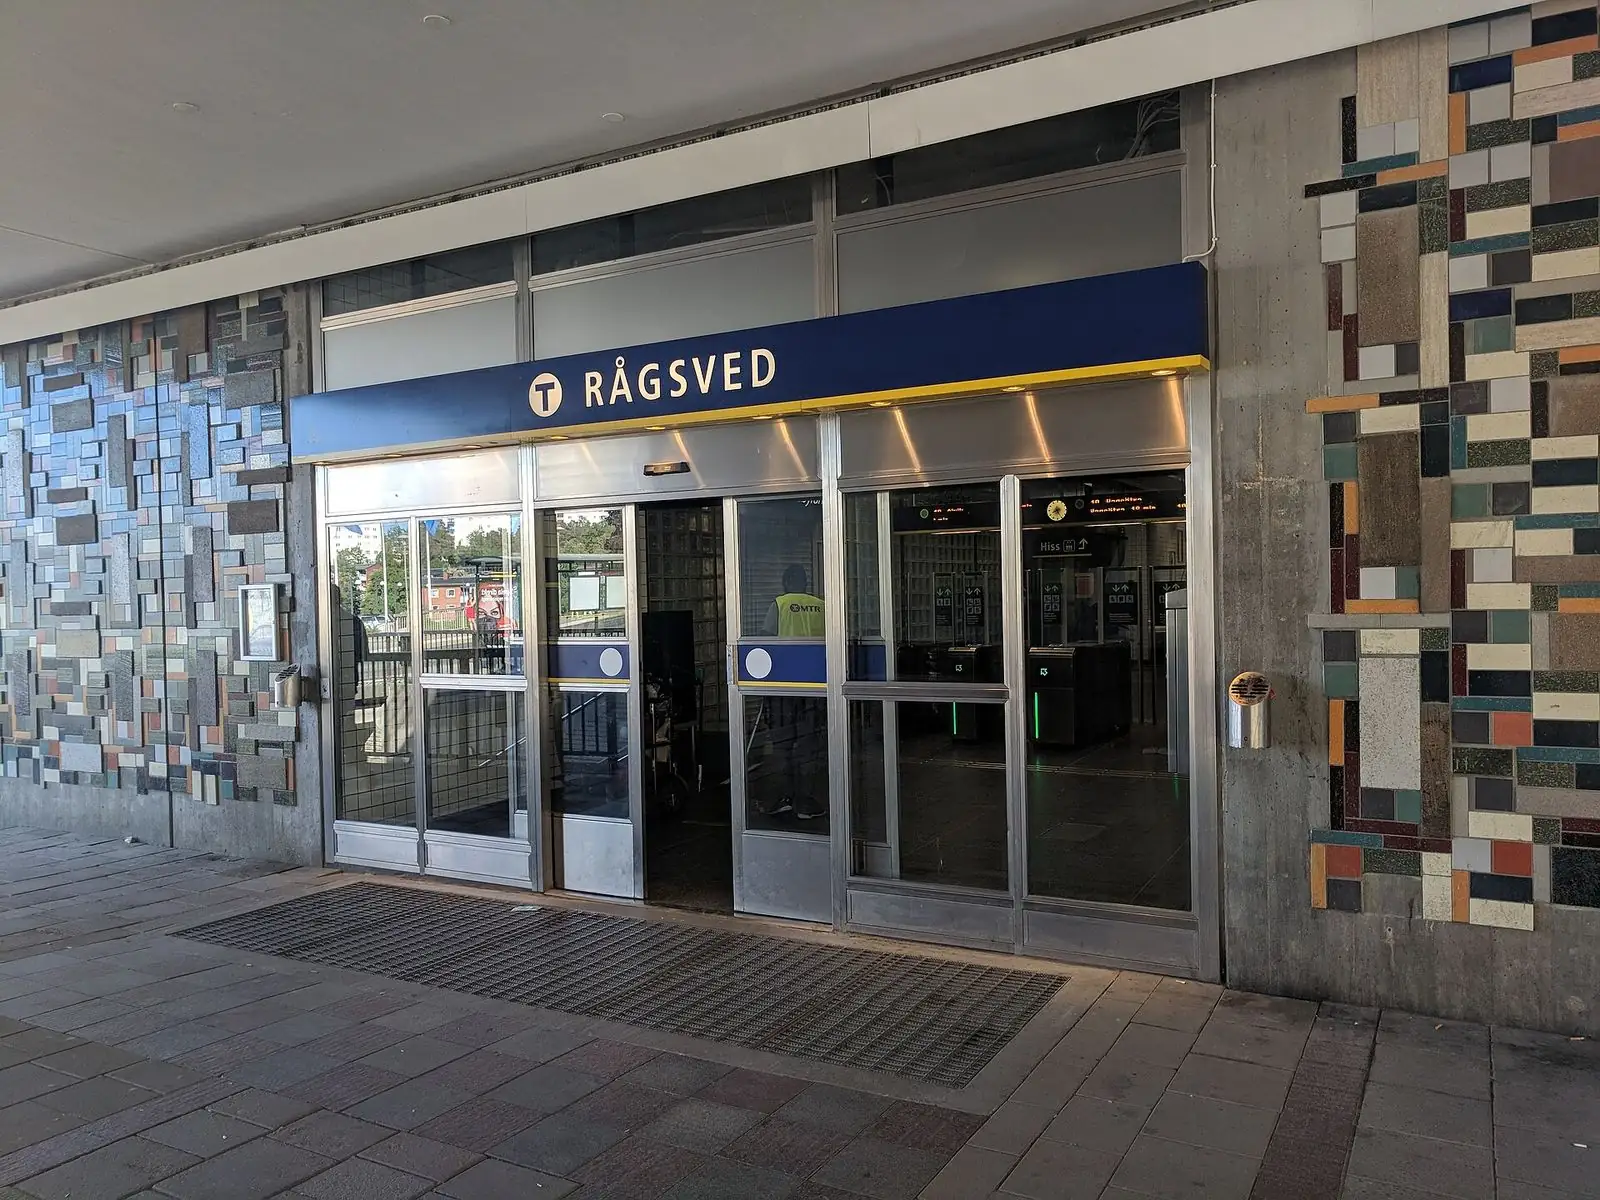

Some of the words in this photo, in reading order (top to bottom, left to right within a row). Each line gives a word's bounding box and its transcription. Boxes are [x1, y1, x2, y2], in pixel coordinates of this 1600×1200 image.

[584, 348, 776, 408] RÅGSVED
[1040, 541, 1061, 552] Hiss
[799, 604, 821, 613] MTR
